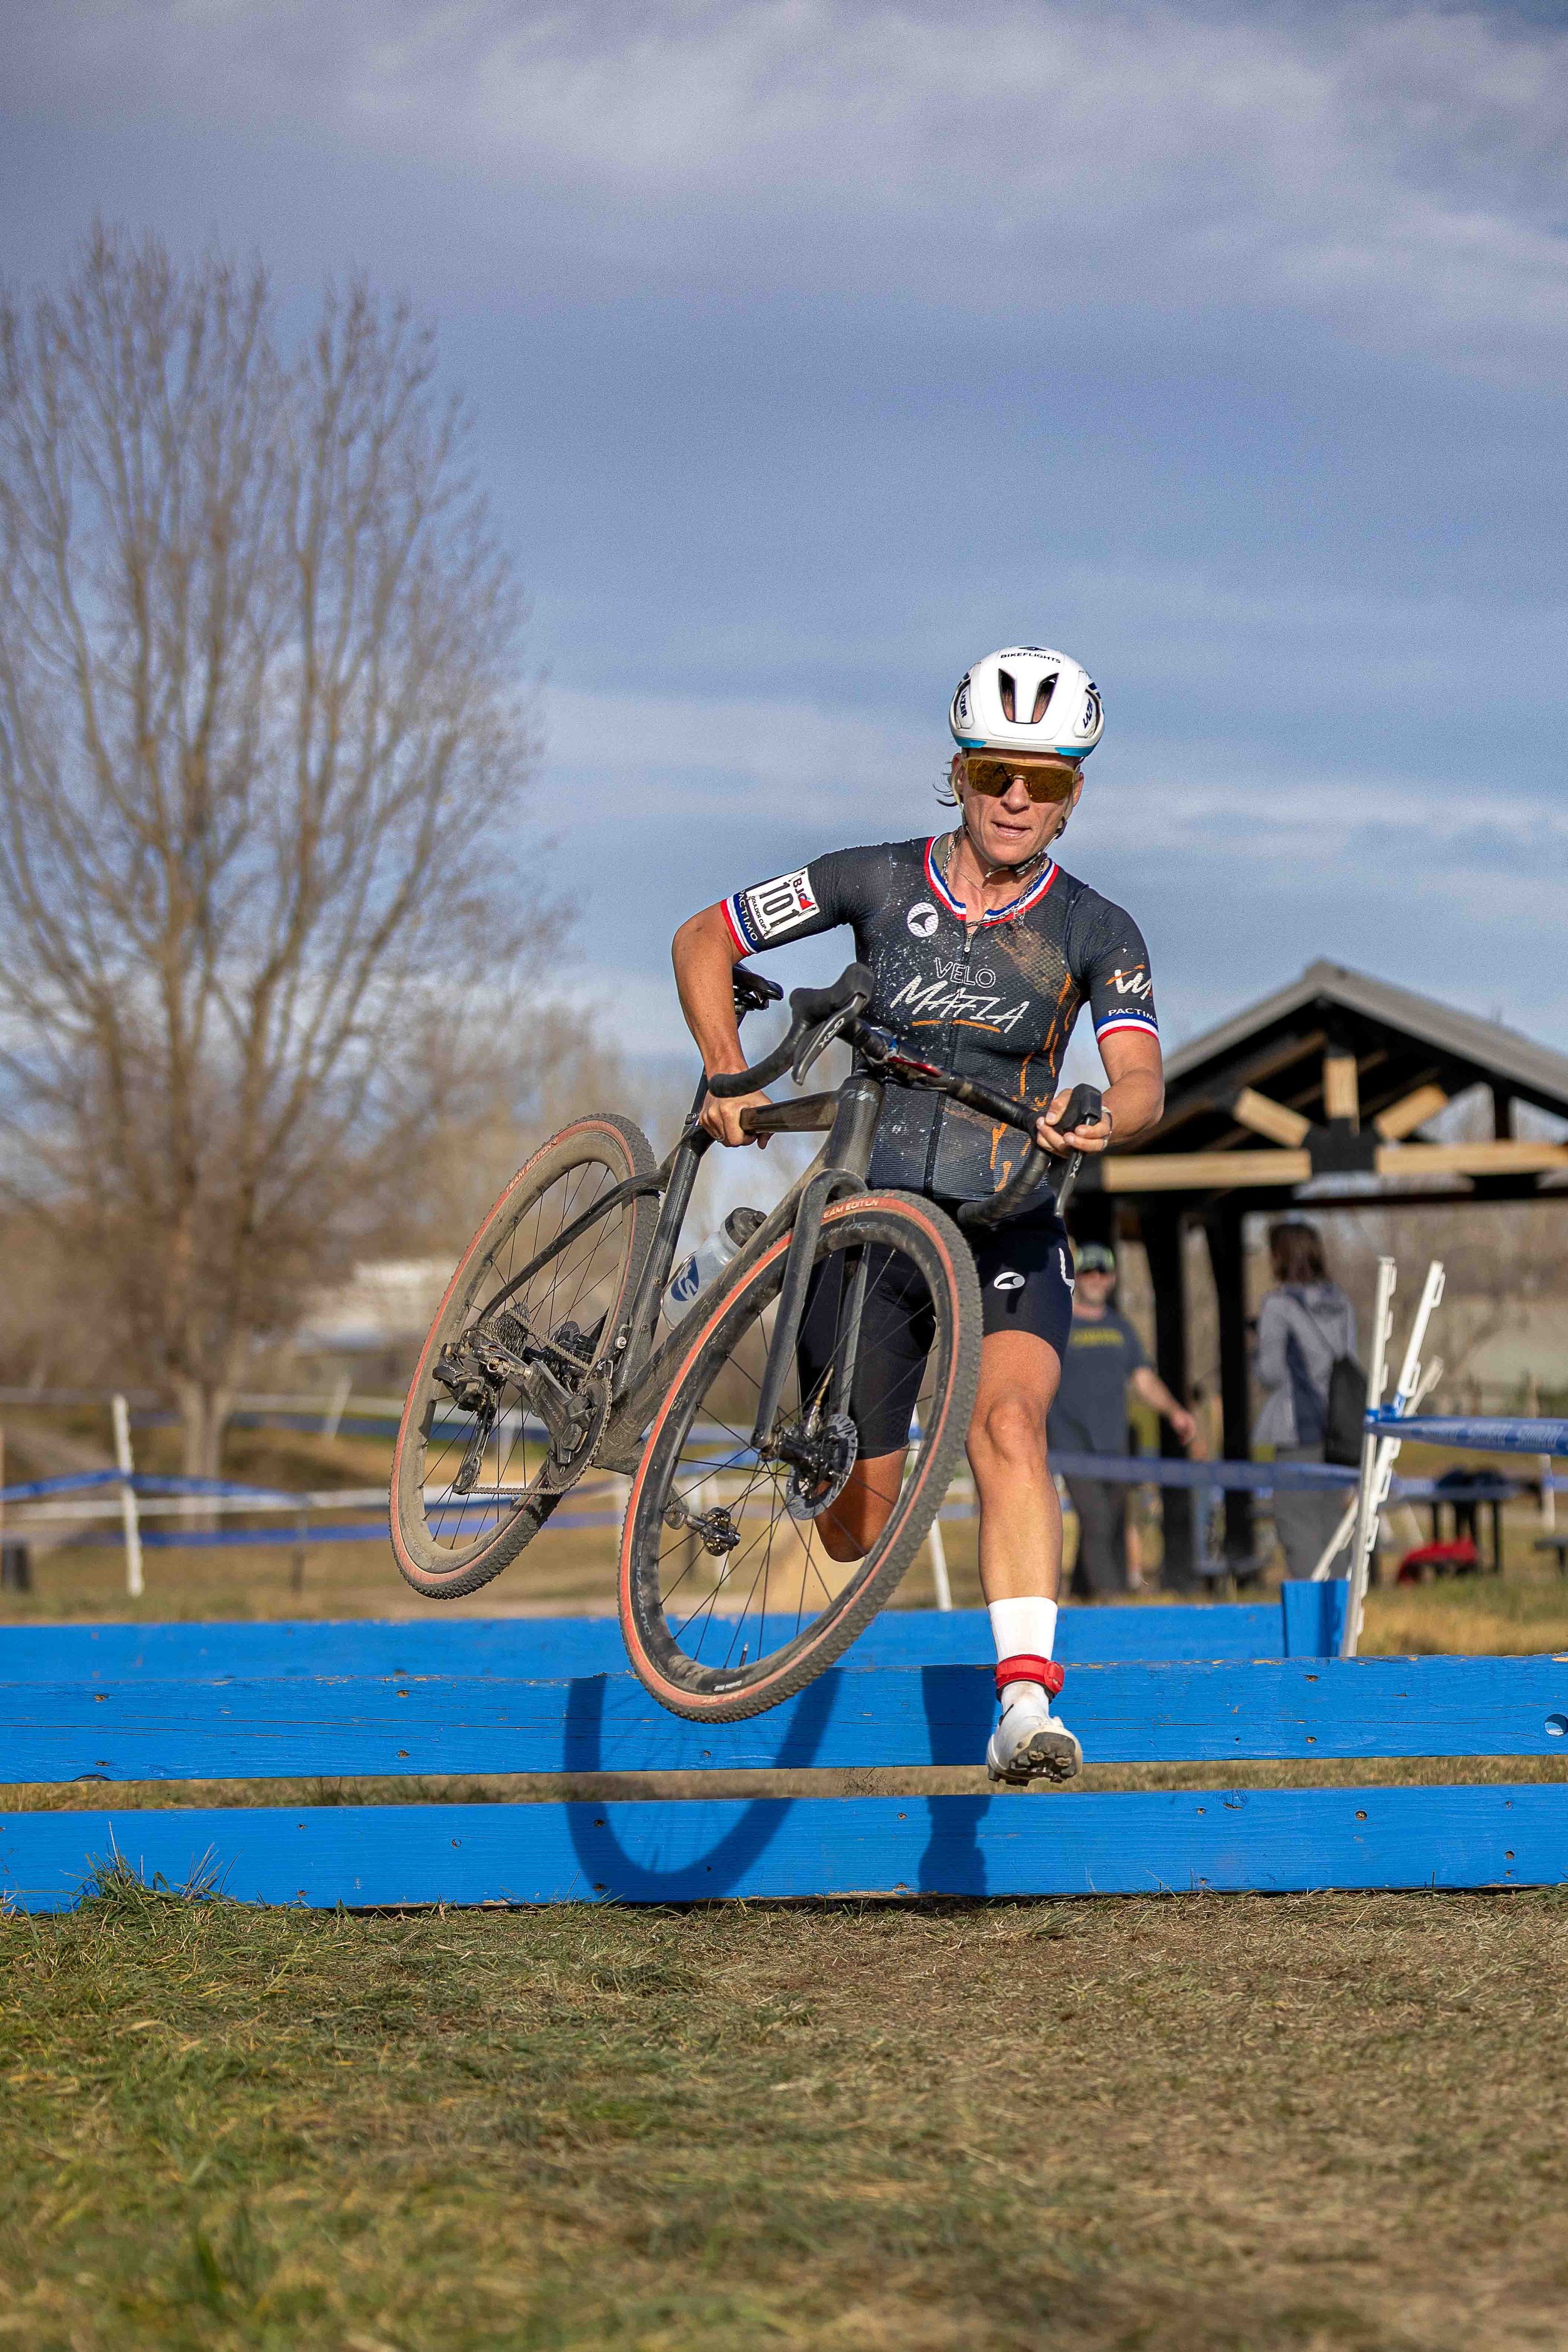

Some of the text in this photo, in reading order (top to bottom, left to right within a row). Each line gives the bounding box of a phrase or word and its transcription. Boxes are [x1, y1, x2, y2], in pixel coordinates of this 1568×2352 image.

[1000, 652, 1061, 663] BIKEFLIGHTS
[760, 881, 800, 928] 101
[934, 957, 996, 988] VELO
[890, 975, 1030, 1034] MAFIA
[506, 1143, 552, 1193] TEAM EDITION
[823, 1205, 844, 1218] EAM
